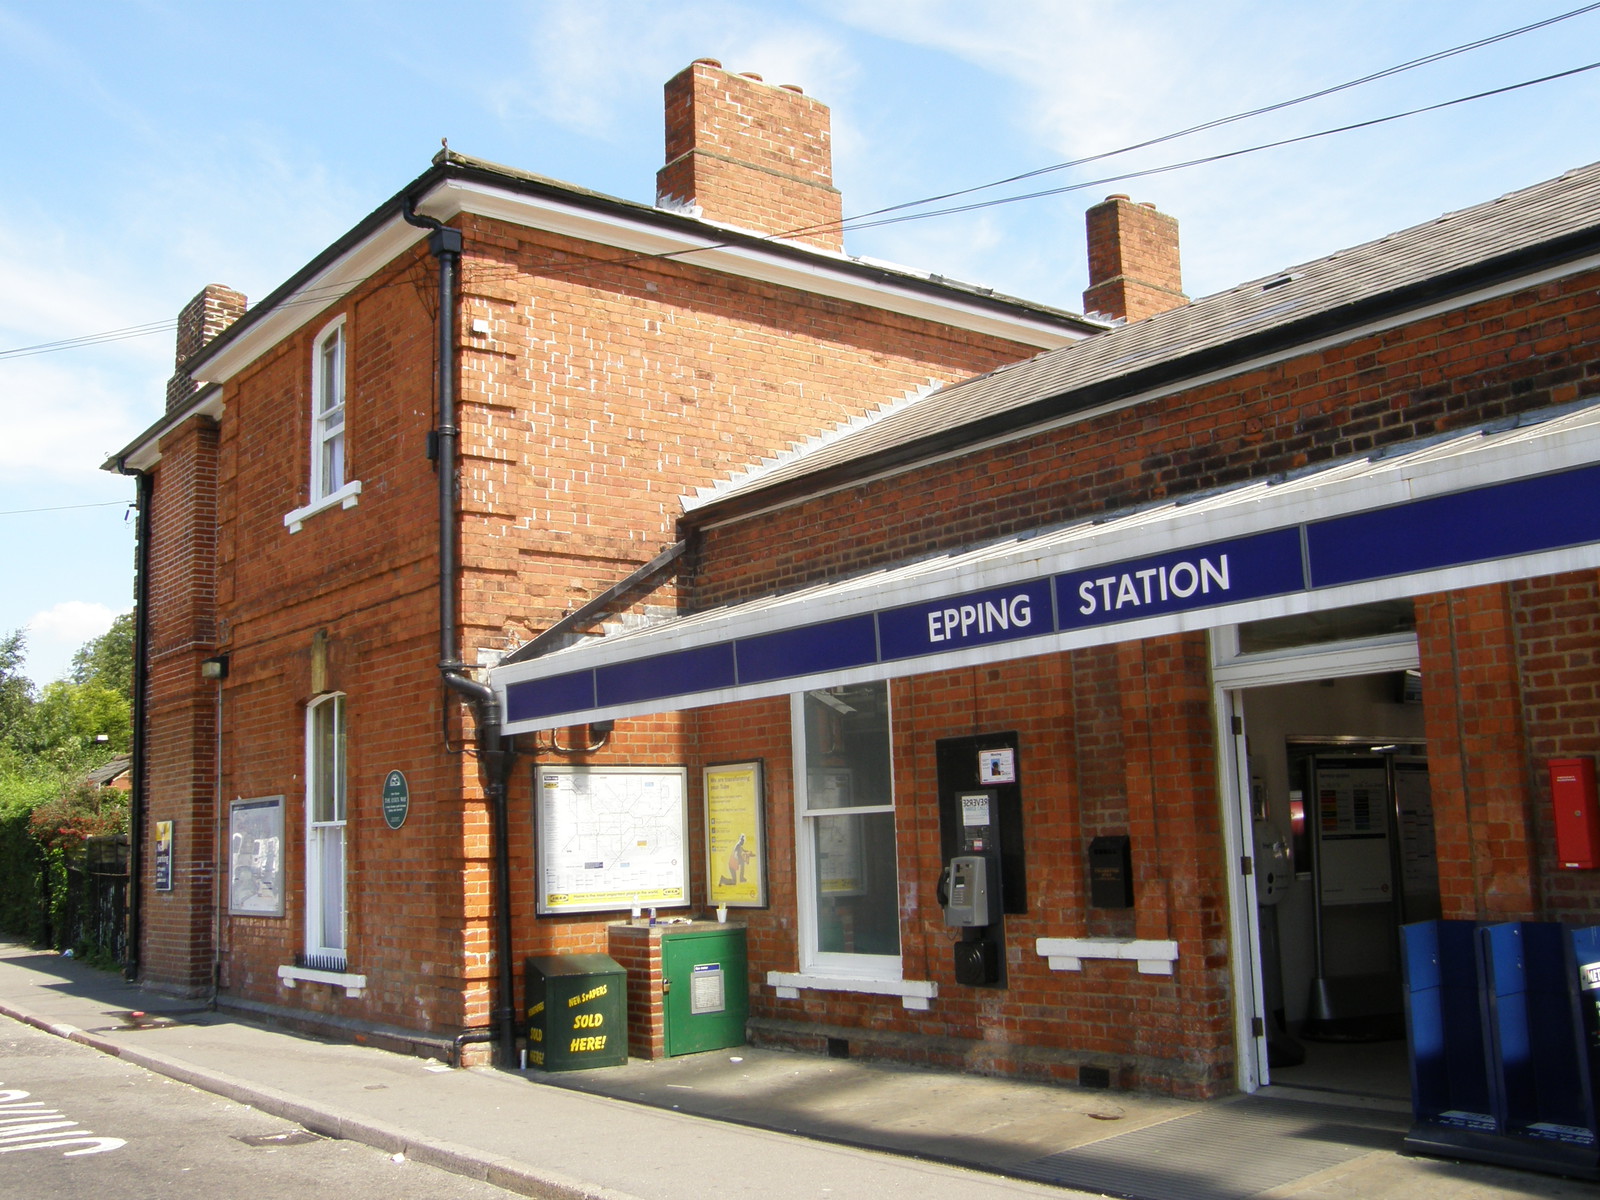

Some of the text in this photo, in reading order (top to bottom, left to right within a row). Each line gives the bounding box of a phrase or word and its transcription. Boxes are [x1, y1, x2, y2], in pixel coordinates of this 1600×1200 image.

[928, 554, 1230, 642] EPPING STATION
[573, 1013, 604, 1030] SOLD
[570, 1036, 607, 1052] HERE!
